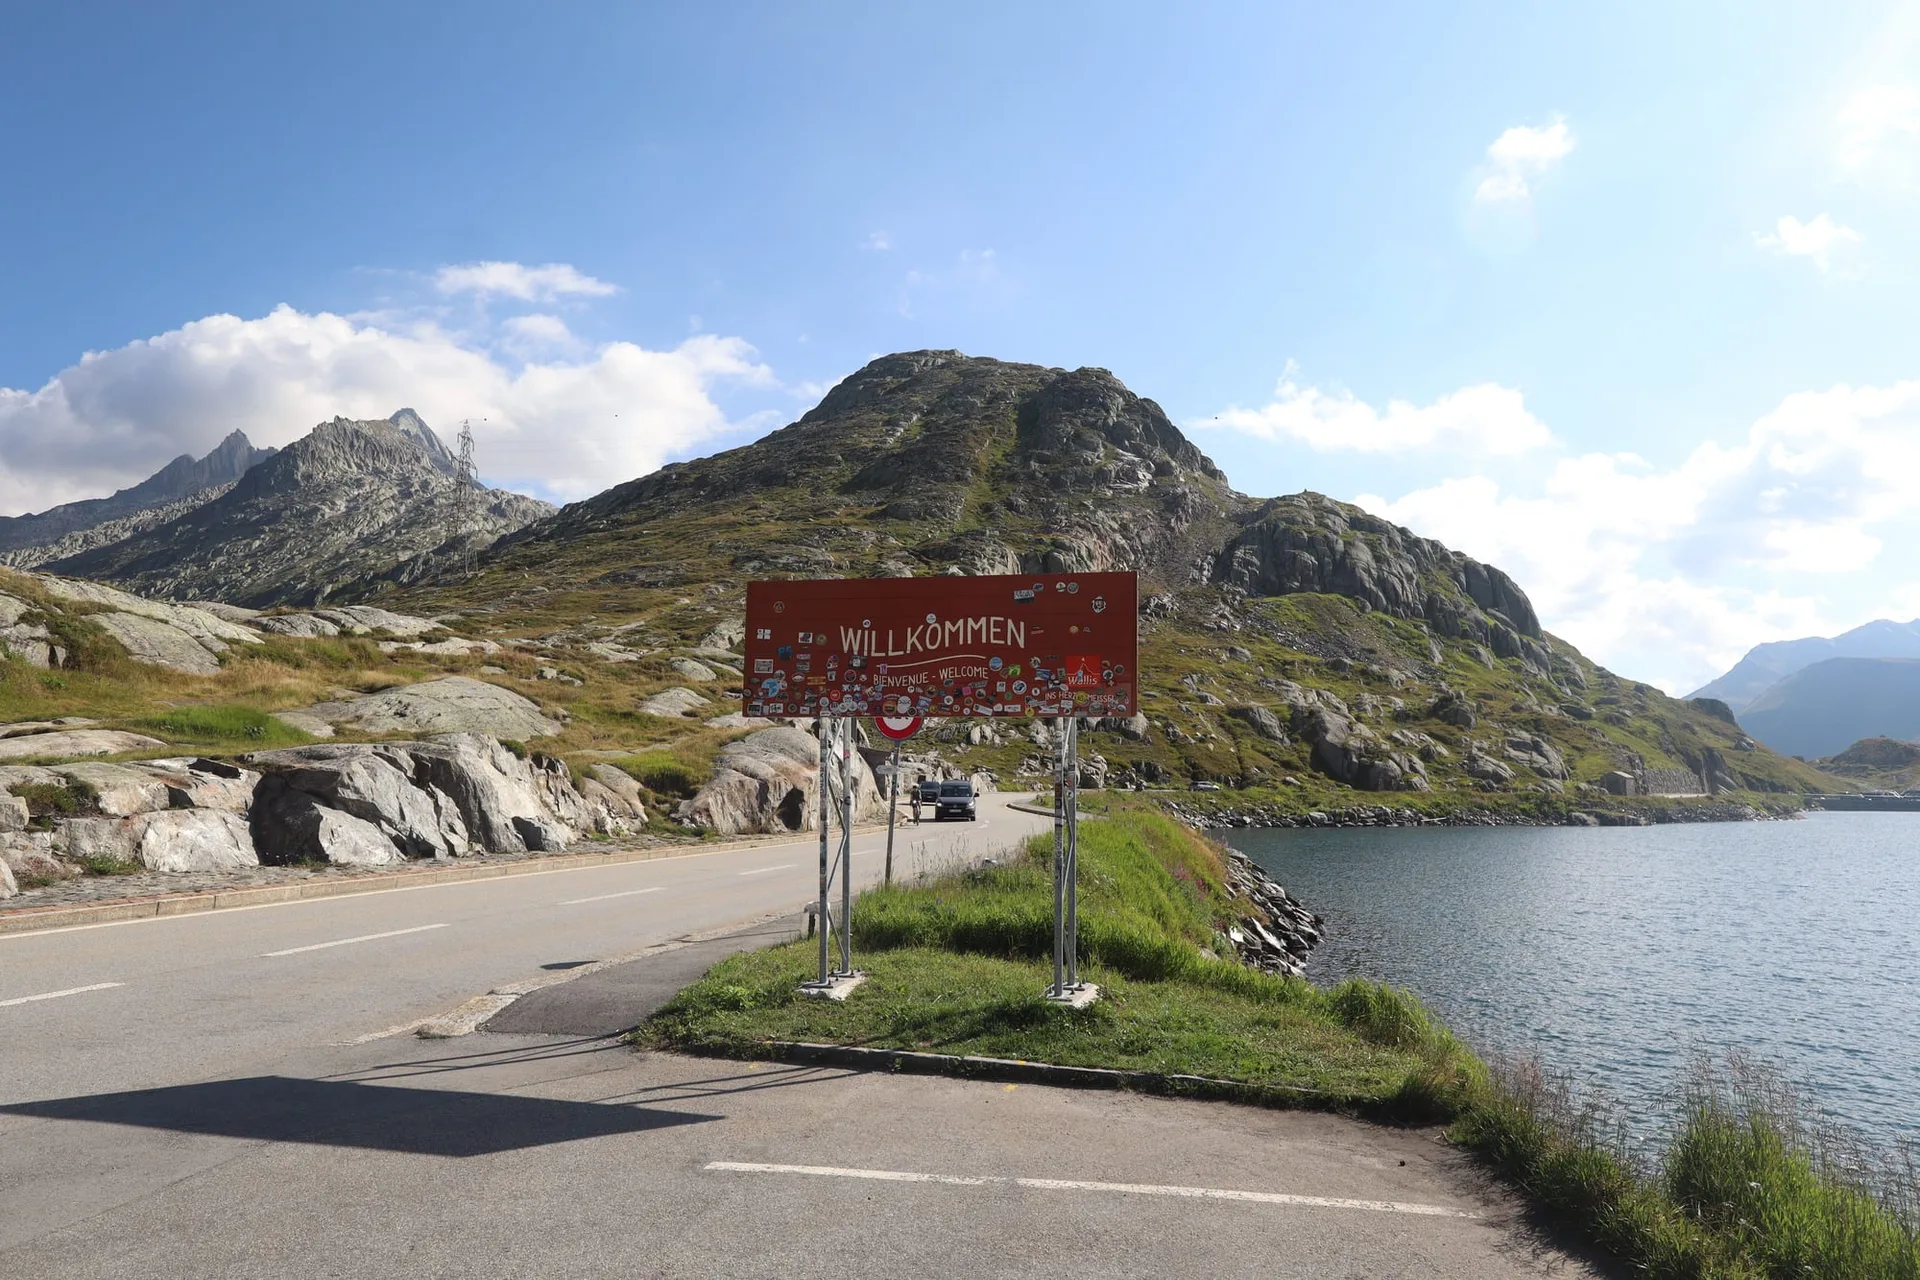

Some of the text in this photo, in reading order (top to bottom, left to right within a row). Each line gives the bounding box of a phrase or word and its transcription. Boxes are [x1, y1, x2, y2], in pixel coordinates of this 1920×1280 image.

[840, 616, 1025, 657] WILLKOMMEN
[873, 671, 929, 687] BIENVENUE
[939, 666, 989, 680] WELCOME
[1068, 675, 1098, 685] Wallis
[1045, 692, 1057, 700] INS
